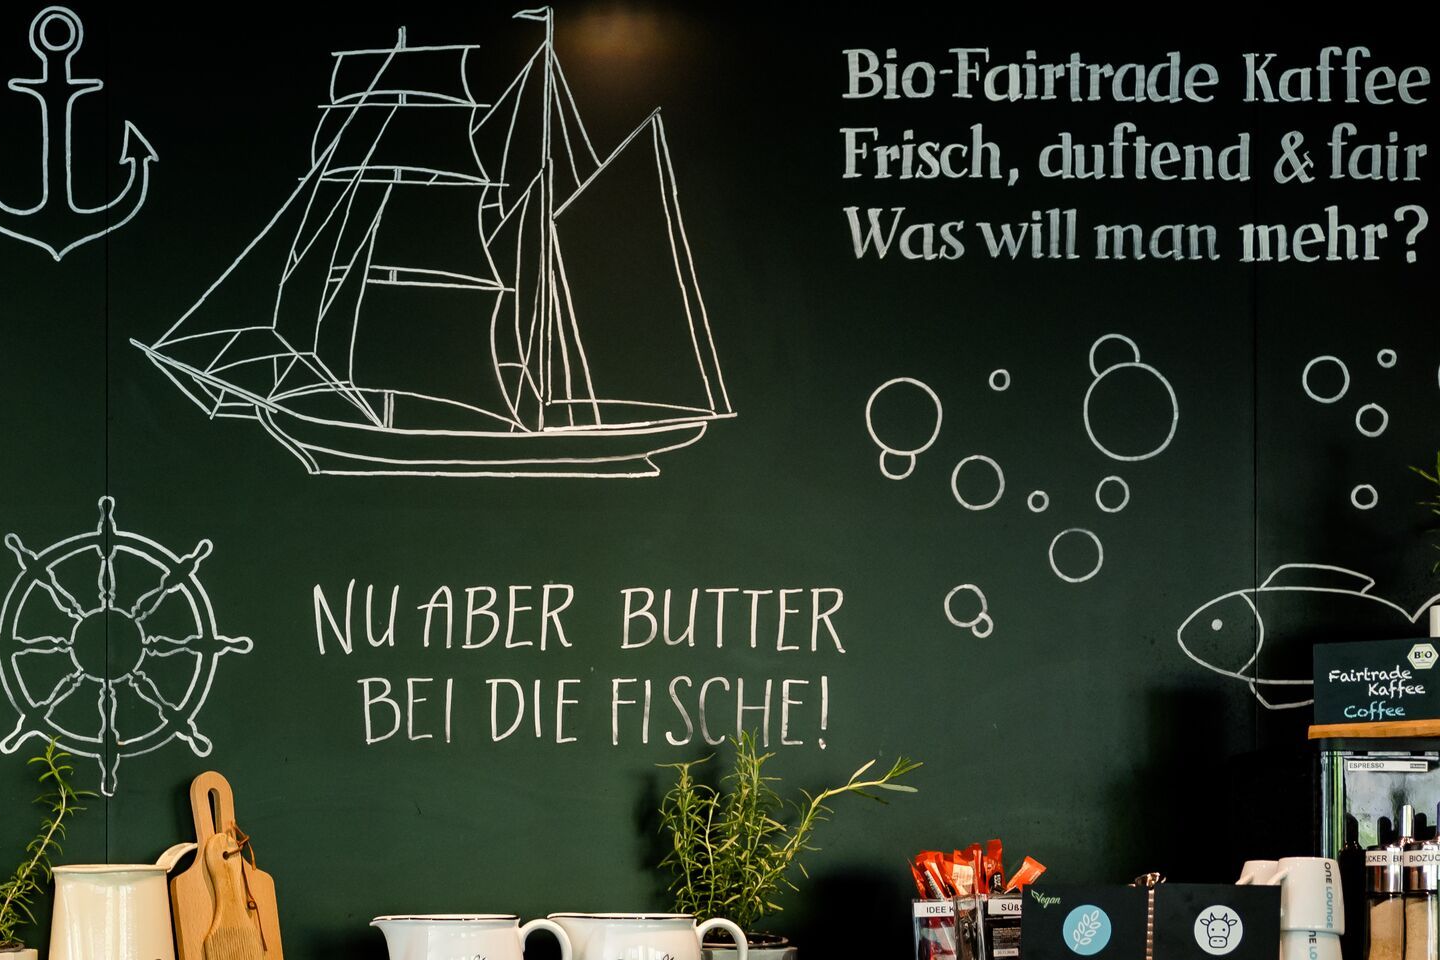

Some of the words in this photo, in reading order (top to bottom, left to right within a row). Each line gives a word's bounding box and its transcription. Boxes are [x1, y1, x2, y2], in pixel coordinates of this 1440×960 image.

[841, 48, 1219, 103] Bio-Fairtrade
[1242, 46, 1430, 104] Kaffee
[839, 123, 1020, 186] Frisch,
[1038, 122, 1251, 182] duftend
[1273, 130, 1315, 184] &
[1328, 122, 1427, 182] fair
[843, 206, 965, 260] Was
[976, 208, 1080, 259] will
[1094, 221, 1220, 261] man
[1239, 204, 1429, 263] mehr?
[313, 579, 399, 655] NU
[417, 584, 574, 651] ABER
[620, 587, 845, 653] BUTTER
[1328, 665, 1412, 682] Fairtrade
[1368, 679, 1425, 699] Kaffee
[357, 677, 453, 745] BEI
[486, 678, 581, 743] DIE
[612, 675, 830, 749] FISCHE!
[1344, 701, 1405, 720] Coffee
[926, 906, 947, 914] IDEE
[1033, 890, 1061, 909] Vegan
